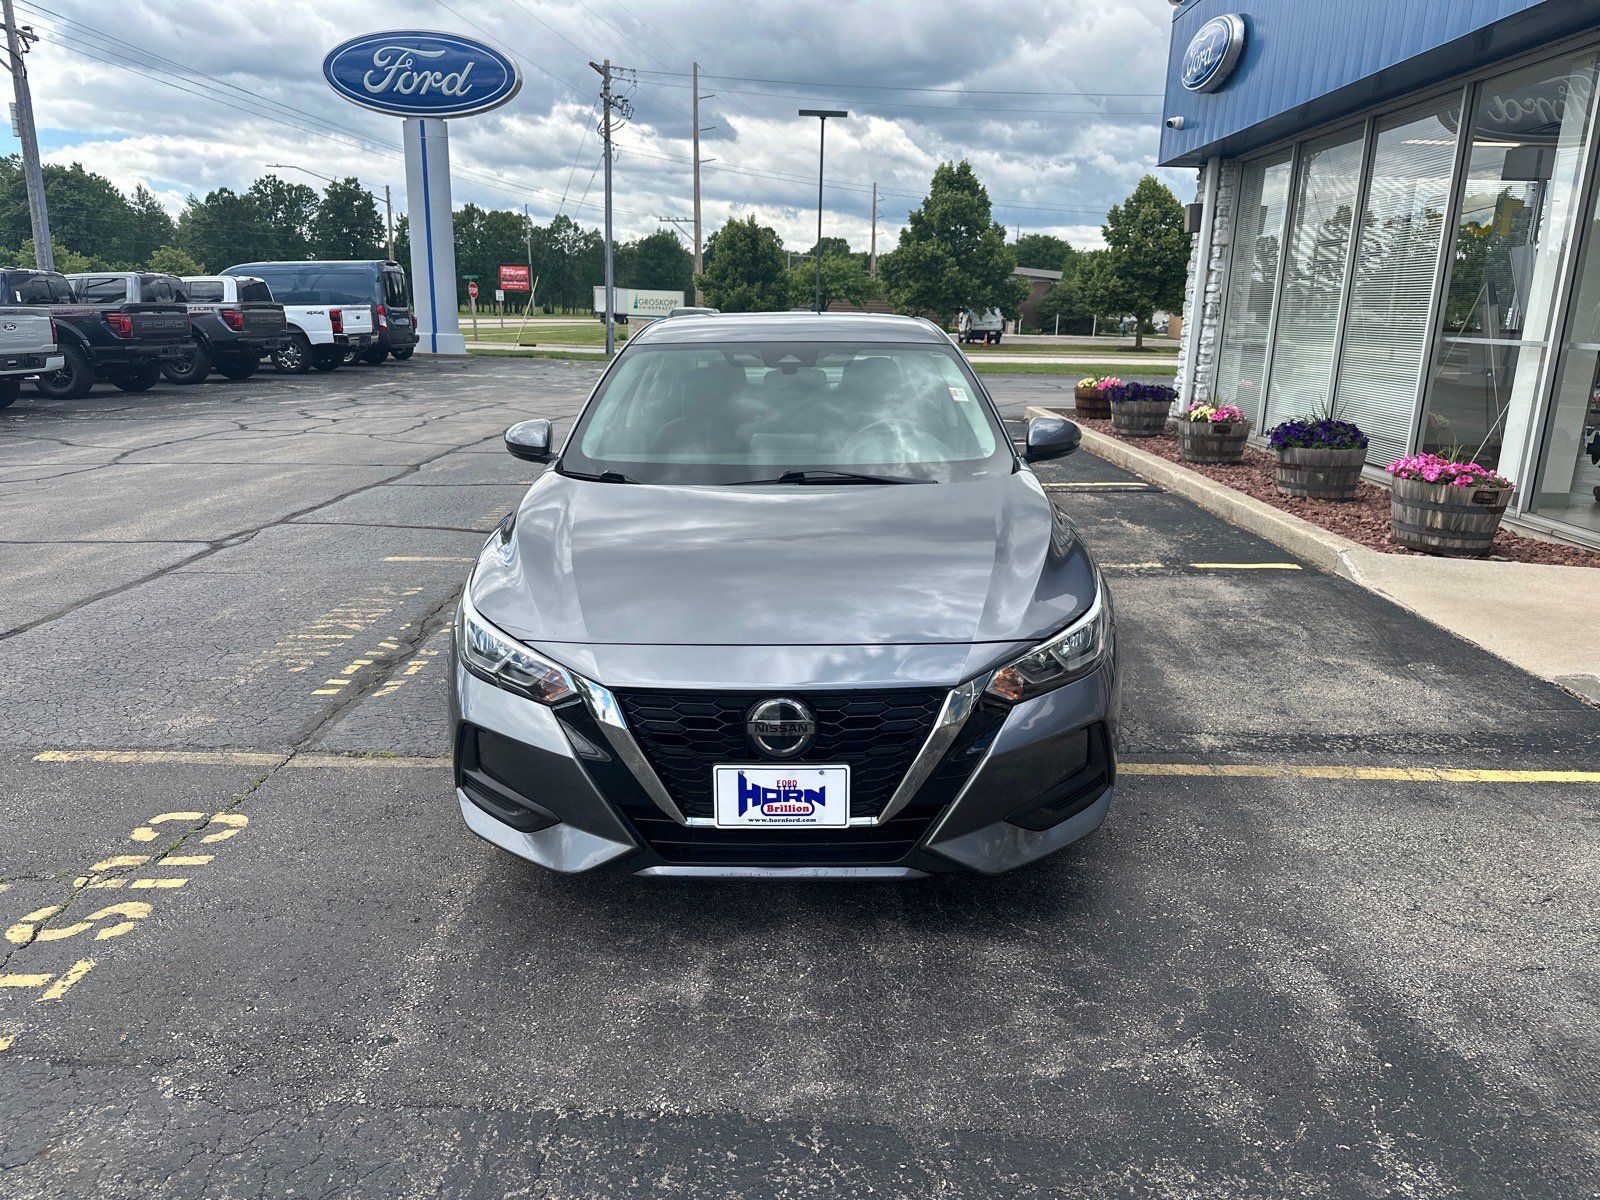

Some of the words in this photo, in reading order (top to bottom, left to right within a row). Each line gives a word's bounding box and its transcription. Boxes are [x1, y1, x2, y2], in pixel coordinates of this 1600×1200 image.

[1184, 33, 1216, 79] Ford
[363, 46, 475, 96] Ford
[638, 298, 678, 306] GROSKOPP
[754, 723, 808, 733] NISSAN
[776, 780, 798, 788] FORD
[738, 771, 826, 817] HORN
[766, 804, 810, 813] Brillion
